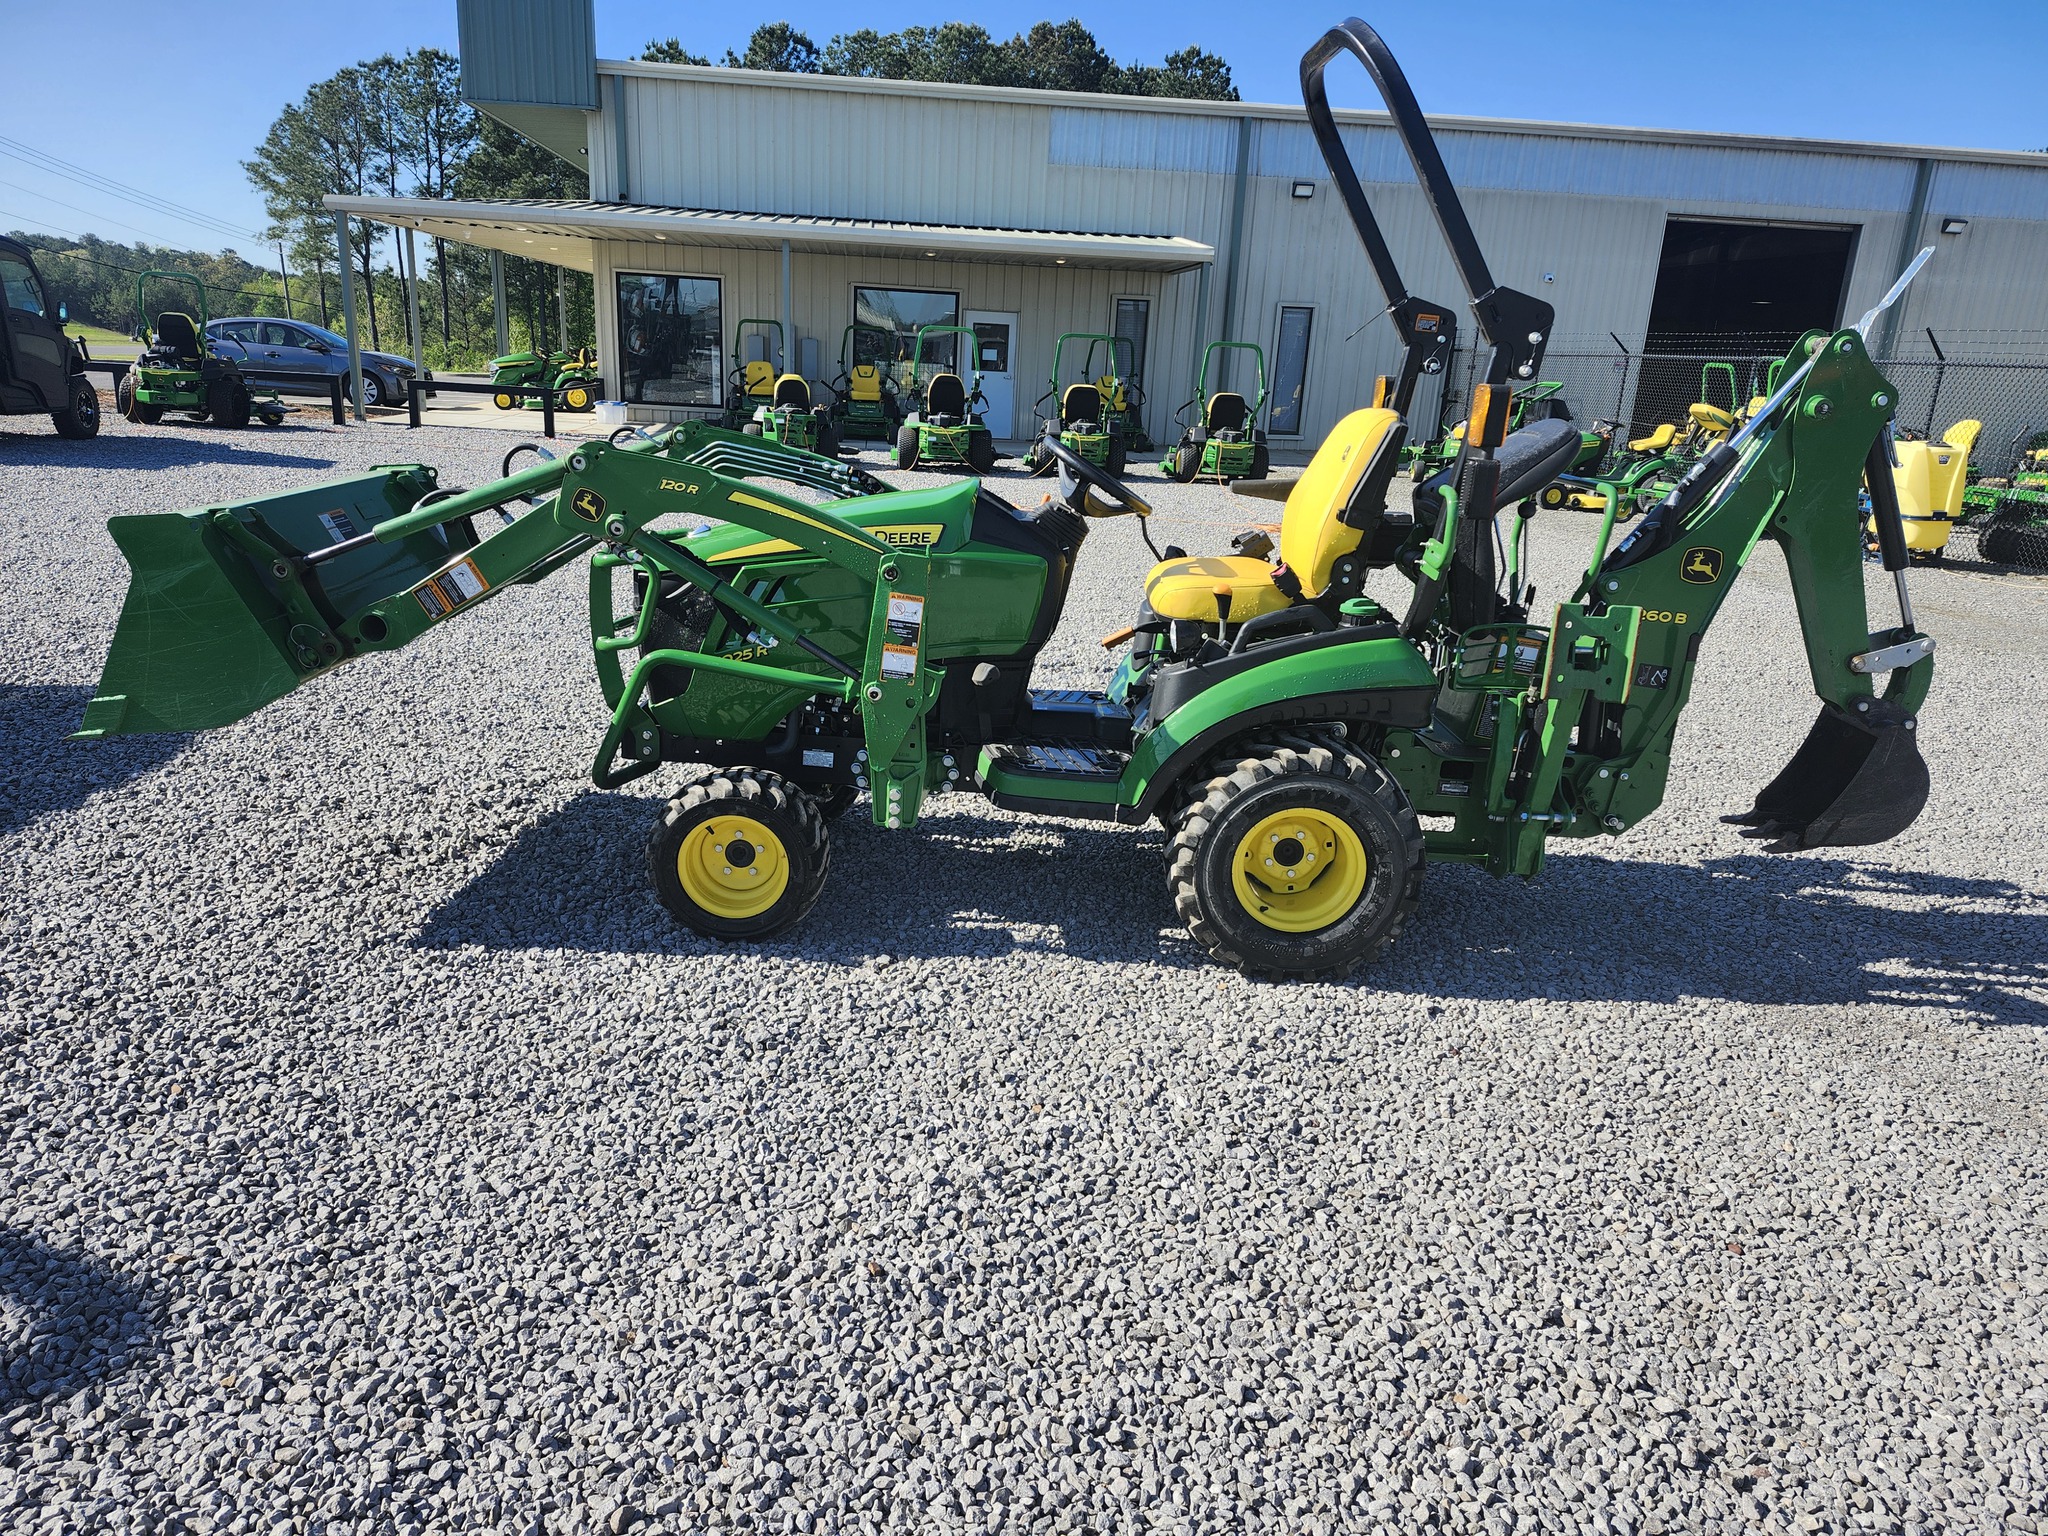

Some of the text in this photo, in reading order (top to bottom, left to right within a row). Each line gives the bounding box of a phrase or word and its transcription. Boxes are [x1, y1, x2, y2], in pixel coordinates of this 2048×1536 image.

[660, 479, 699, 495] 120 R
[875, 531, 931, 543] DEERE
[1674, 612, 1688, 624] B
[756, 645, 768, 657] R
